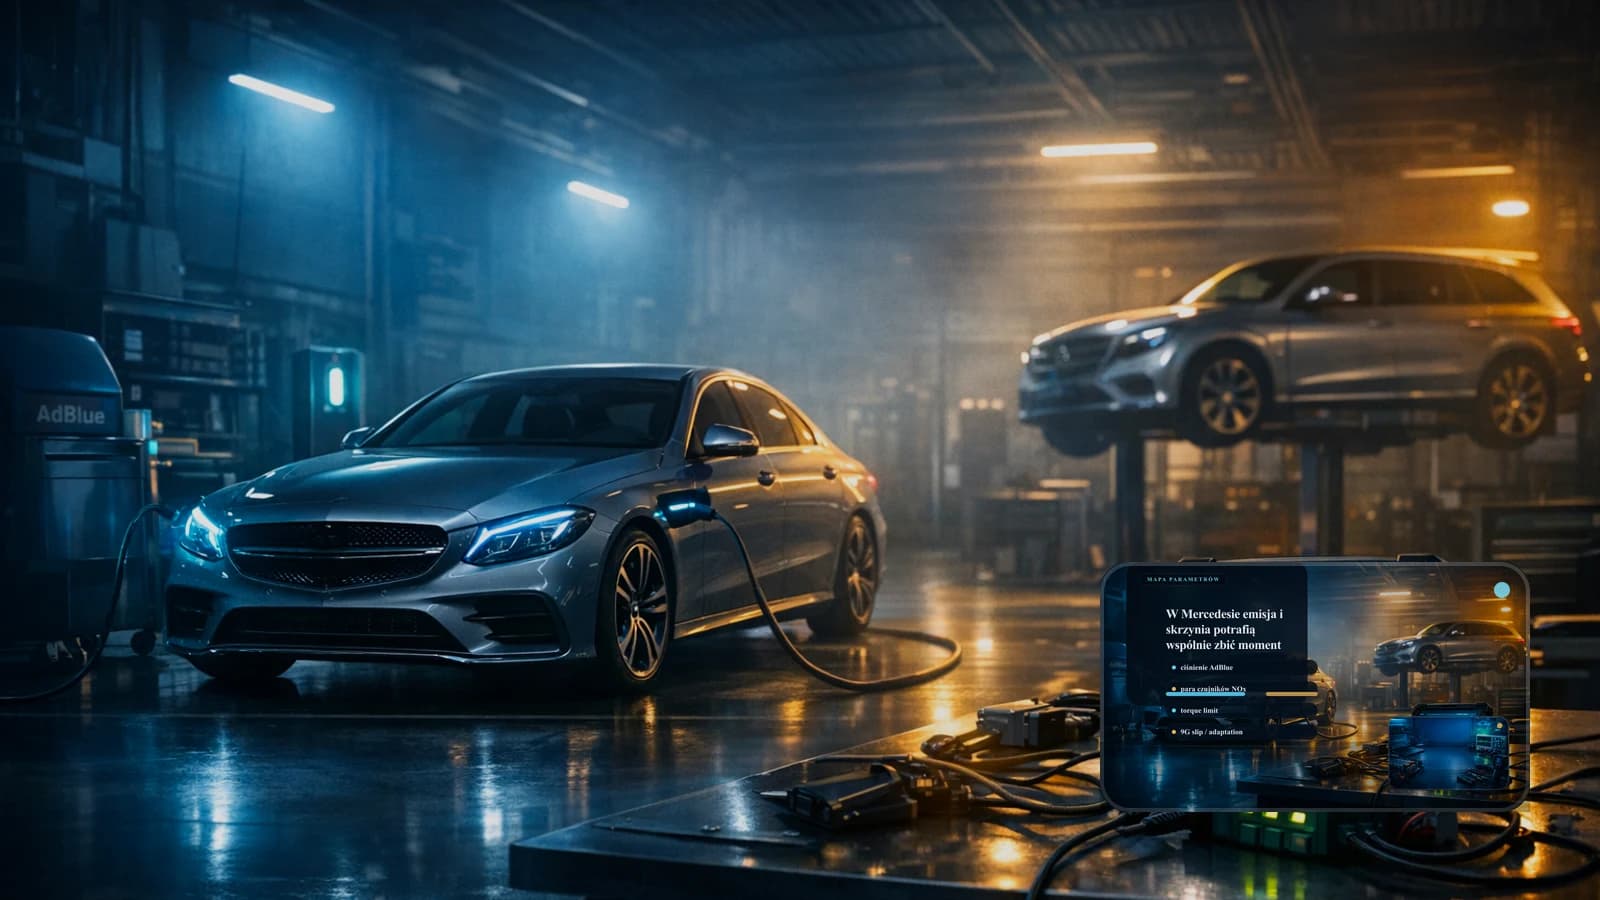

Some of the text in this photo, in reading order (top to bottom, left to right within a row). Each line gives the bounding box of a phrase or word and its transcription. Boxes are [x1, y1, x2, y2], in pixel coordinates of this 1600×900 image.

[37, 404, 105, 425] AdBlue
[1166, 608, 1284, 622] W Mercedesie emisja i
[1166, 624, 1256, 638] skrzynia potrafią
[1166, 639, 1282, 653] wspólnie zbić moment
[1180, 707, 1202, 715] torque
[1192, 729, 1204, 737] slip
[1208, 729, 1243, 737] adaptation
